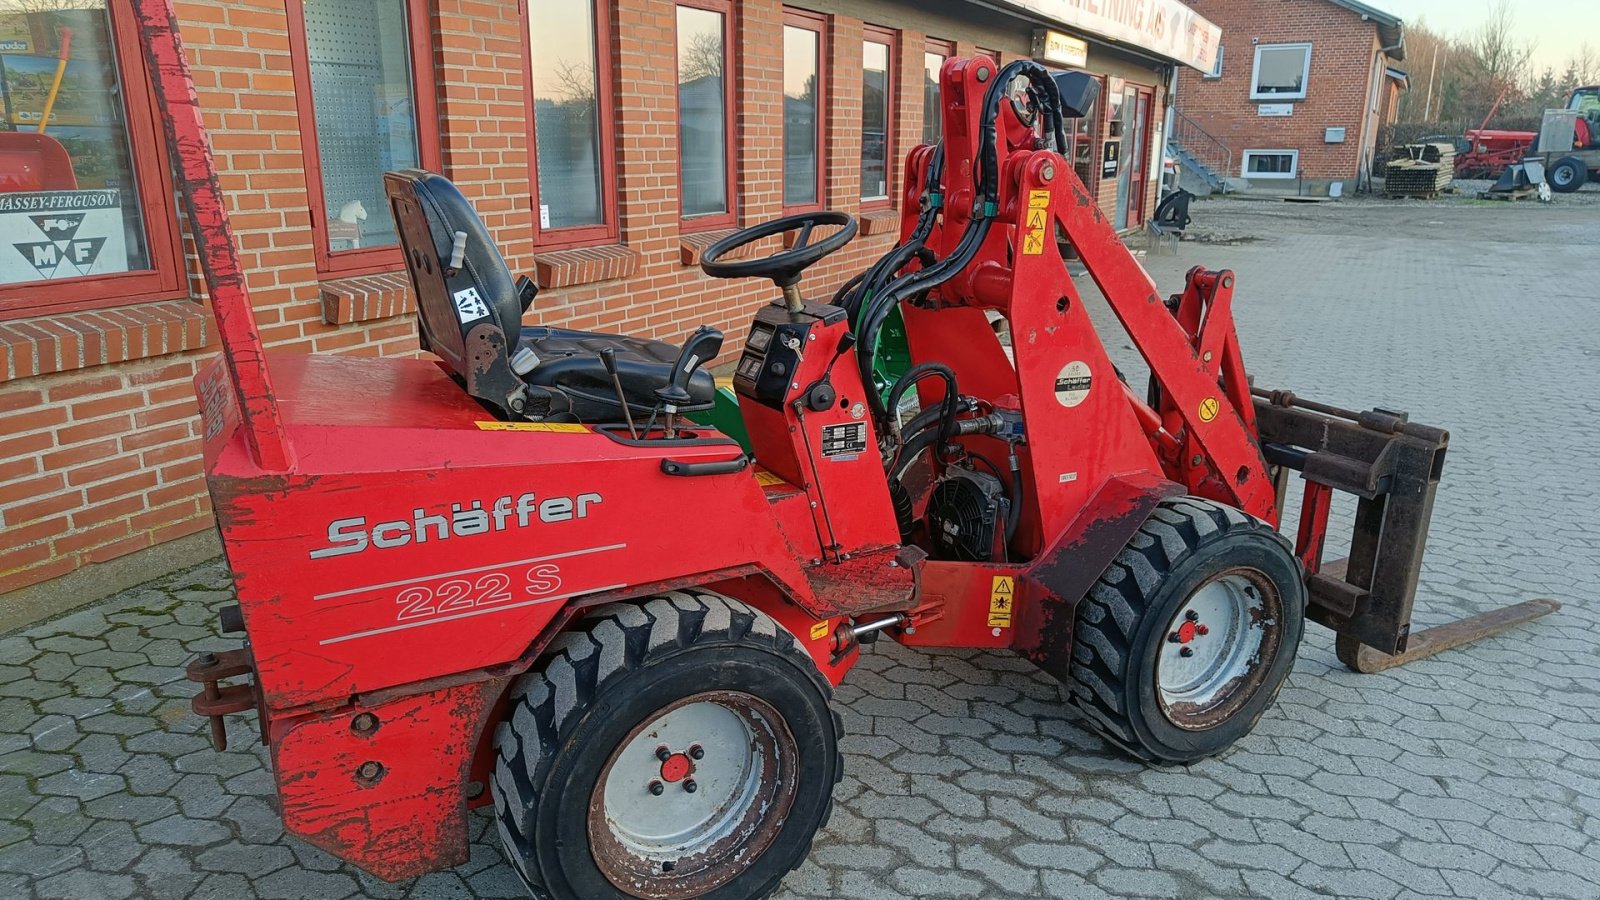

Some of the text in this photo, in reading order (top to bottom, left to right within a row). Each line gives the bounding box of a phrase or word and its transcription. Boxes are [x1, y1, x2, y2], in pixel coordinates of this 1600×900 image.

[0, 41, 26, 50] ruder
[32, 241, 92, 266] M F
[309, 492, 604, 560] Schäffer
[396, 564, 562, 620] 222 S
